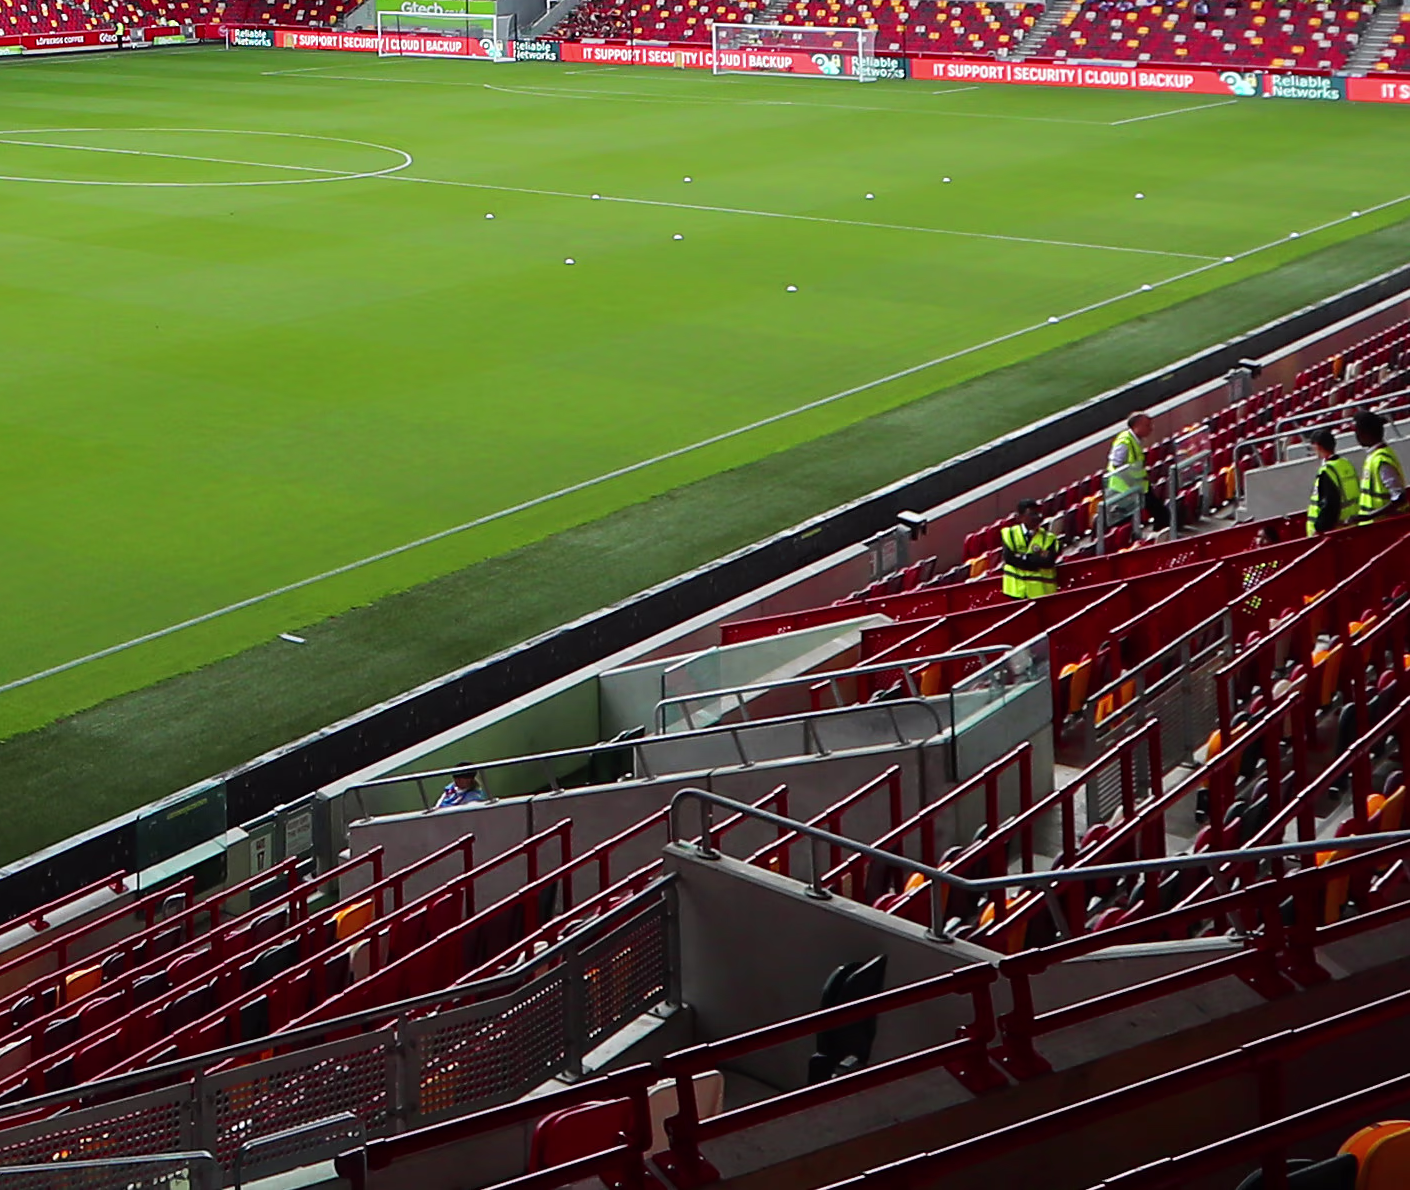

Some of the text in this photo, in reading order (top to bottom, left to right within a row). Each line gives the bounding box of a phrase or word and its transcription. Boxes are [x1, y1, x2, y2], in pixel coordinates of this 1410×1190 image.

[234, 28, 267, 38] Reliable
[391, 39, 419, 52] CLOUD
[426, 40, 462, 52] BACKUP
[513, 40, 551, 51] Reliable
[513, 50, 556, 61] Networks
[583, 48, 591, 59] IT
[648, 49, 698, 64] SECUITY
[749, 54, 792, 68] BACKUP
[851, 56, 898, 69] Reliable
[851, 66, 904, 79] Networks
[933, 63, 1193, 88] IT SUPPORT SECURITY CLOUD BACKUP
[1272, 74, 1331, 88] Reliable
[1272, 86, 1339, 100] Networks
[1381, 83, 1396, 98] IT
